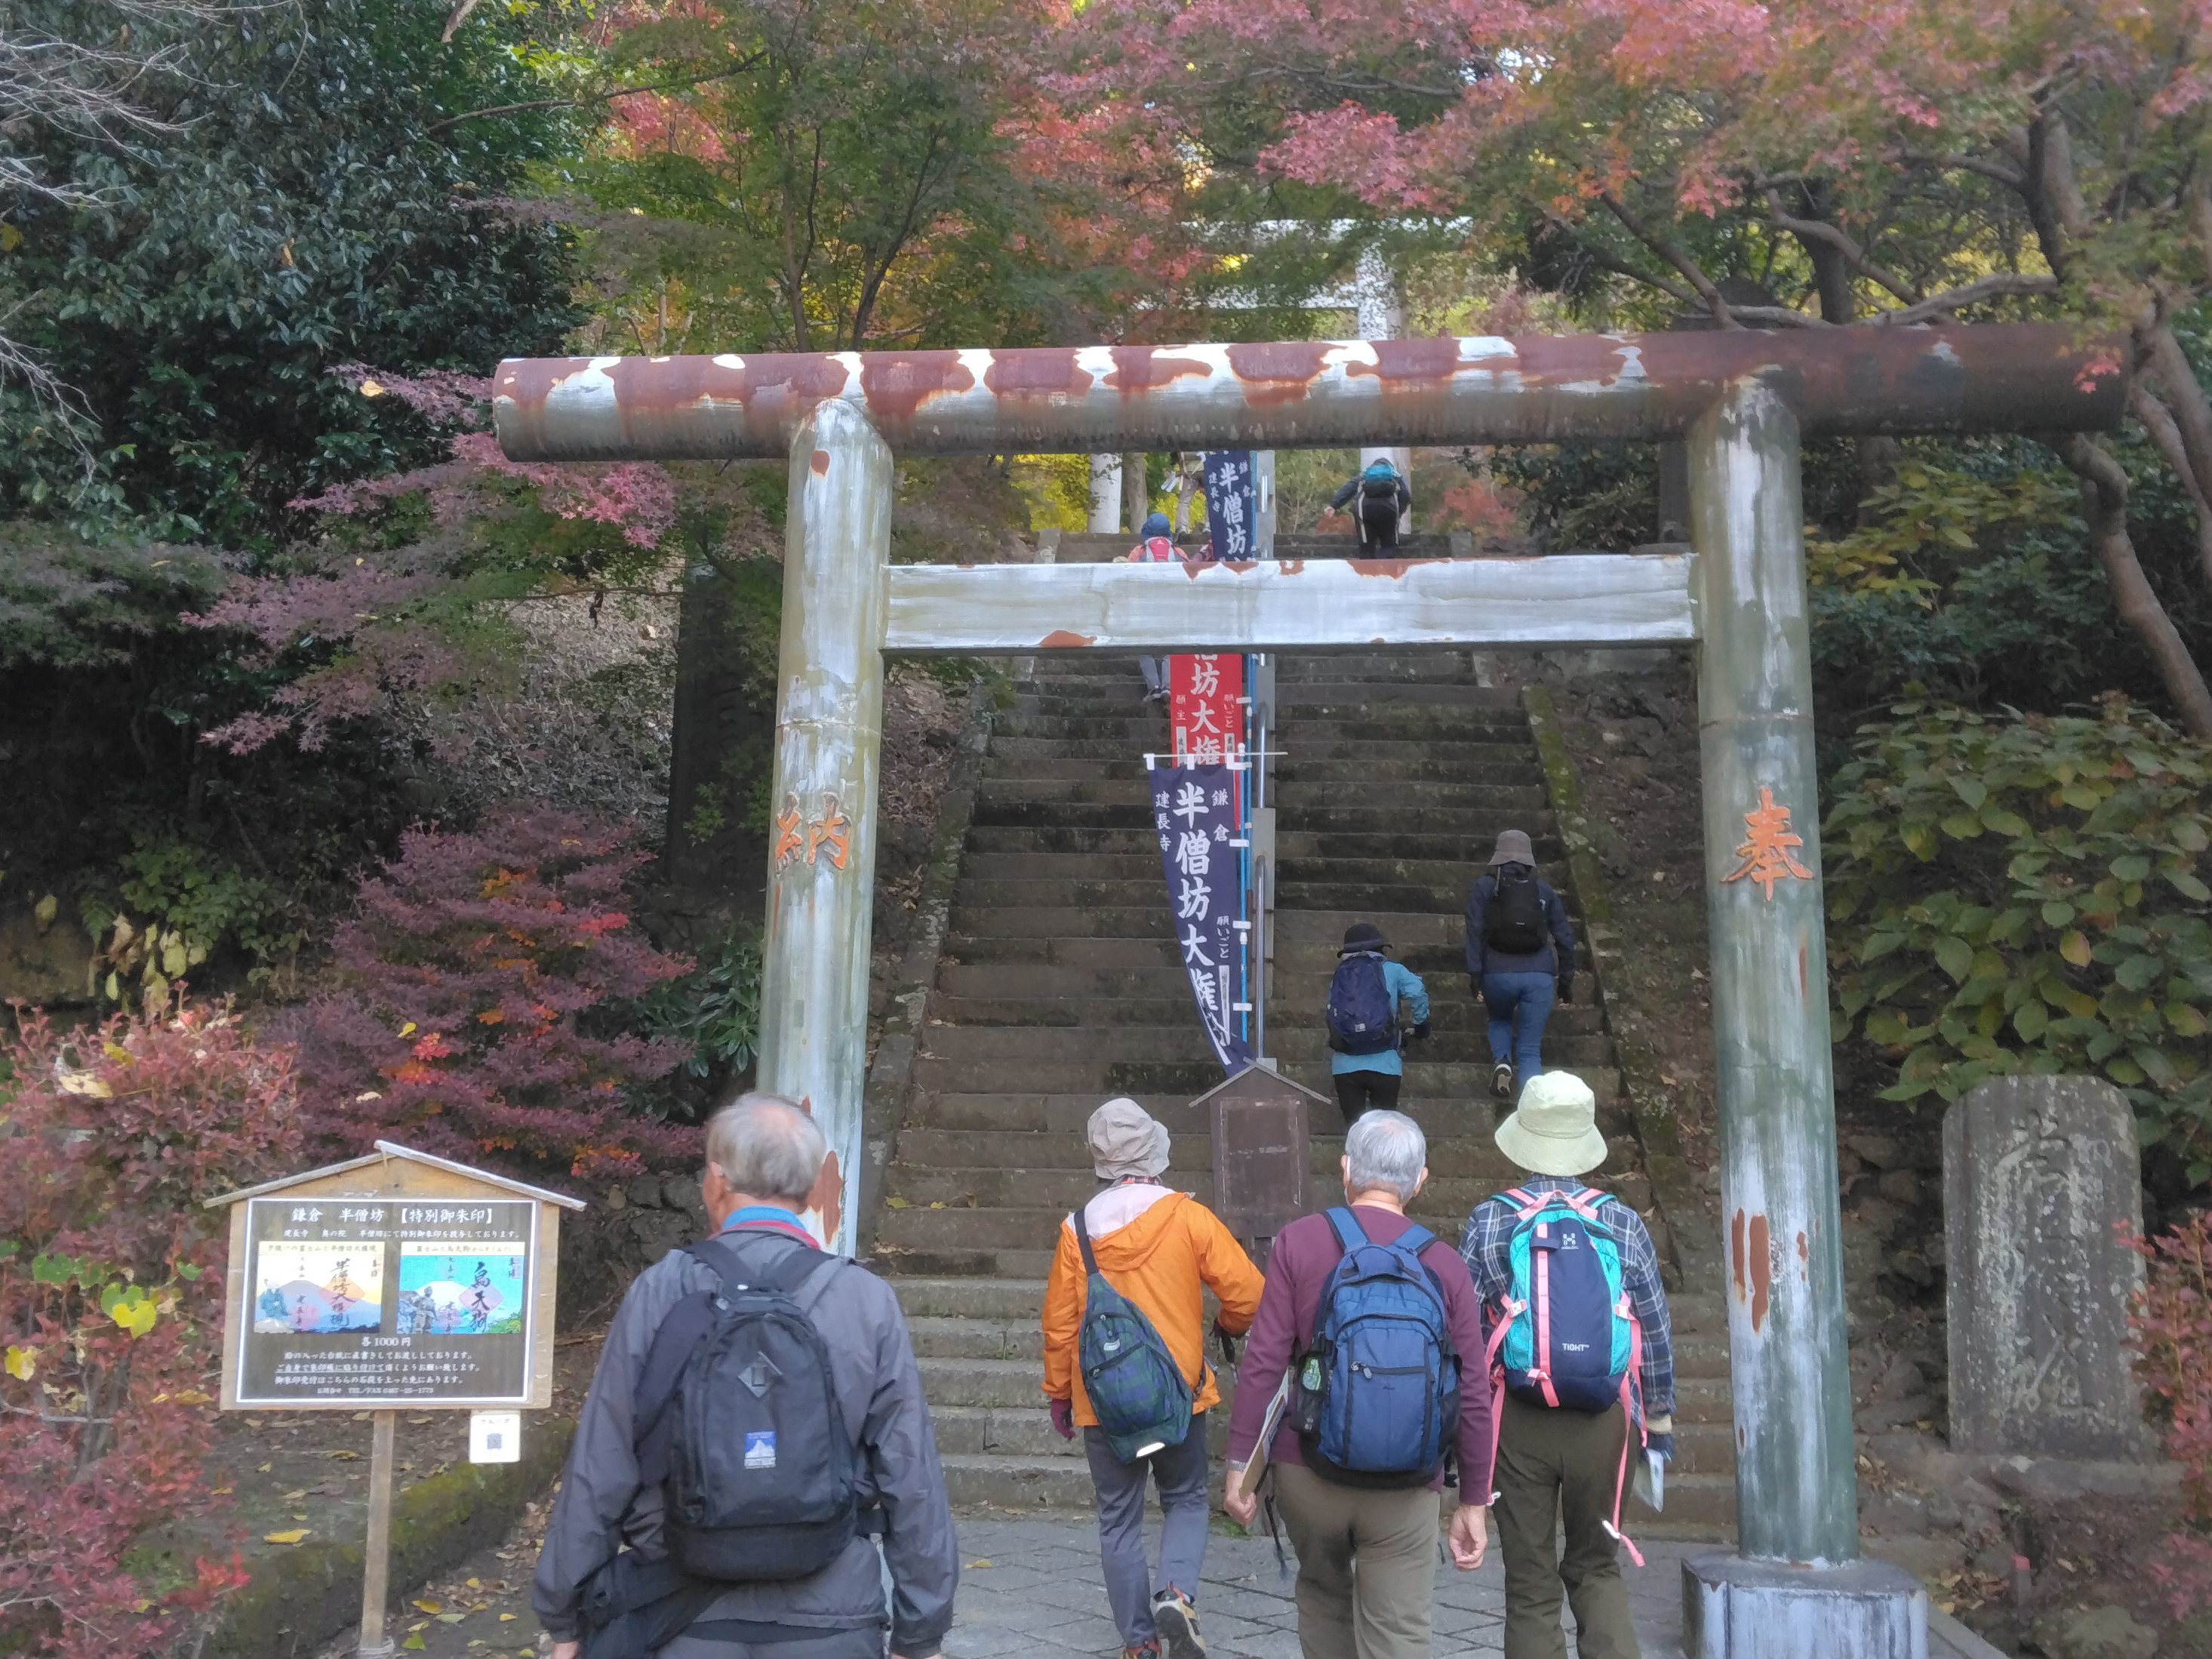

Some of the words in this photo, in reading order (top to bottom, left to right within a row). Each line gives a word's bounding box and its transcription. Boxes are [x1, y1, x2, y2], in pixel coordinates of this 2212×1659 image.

[1219, 462, 1247, 562] 半僧坊
[1190, 654, 1221, 765] 坊大権
[1155, 789, 1172, 853] 建長寺
[1211, 787, 1230, 842] 鎌倉
[1216, 915, 1230, 959] 願いごと
[291, 1207, 324, 1222] 鎌倉
[338, 1207, 386, 1223] 半僧坊
[401, 1208, 493, 1224] 【特別御朱印】
